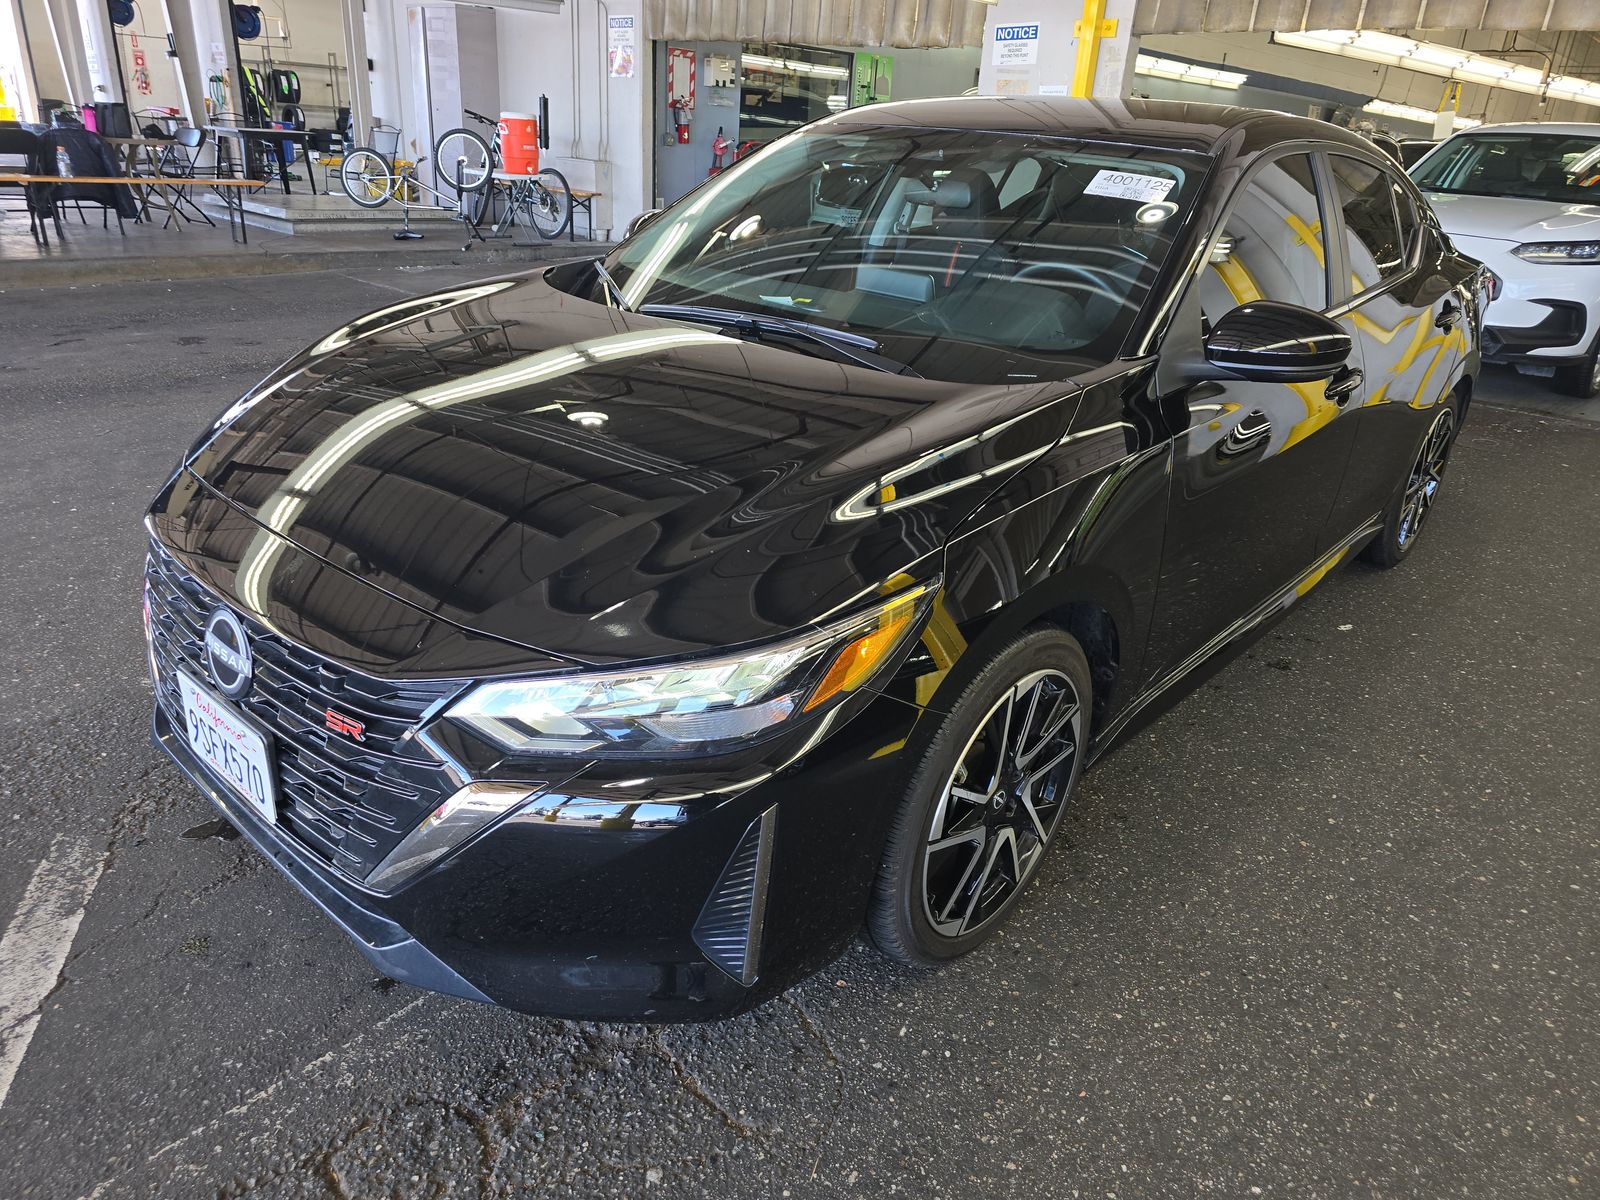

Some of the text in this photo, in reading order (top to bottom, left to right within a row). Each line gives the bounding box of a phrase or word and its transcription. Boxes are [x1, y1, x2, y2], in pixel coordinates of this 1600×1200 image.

[610, 19, 633, 28] NOTICE
[997, 26, 1037, 40] NOTICE
[1103, 174, 1173, 193] 4001125
[195, 692, 243, 741] California
[325, 708, 365, 742] SR
[189, 708, 265, 805] 9SFX570
